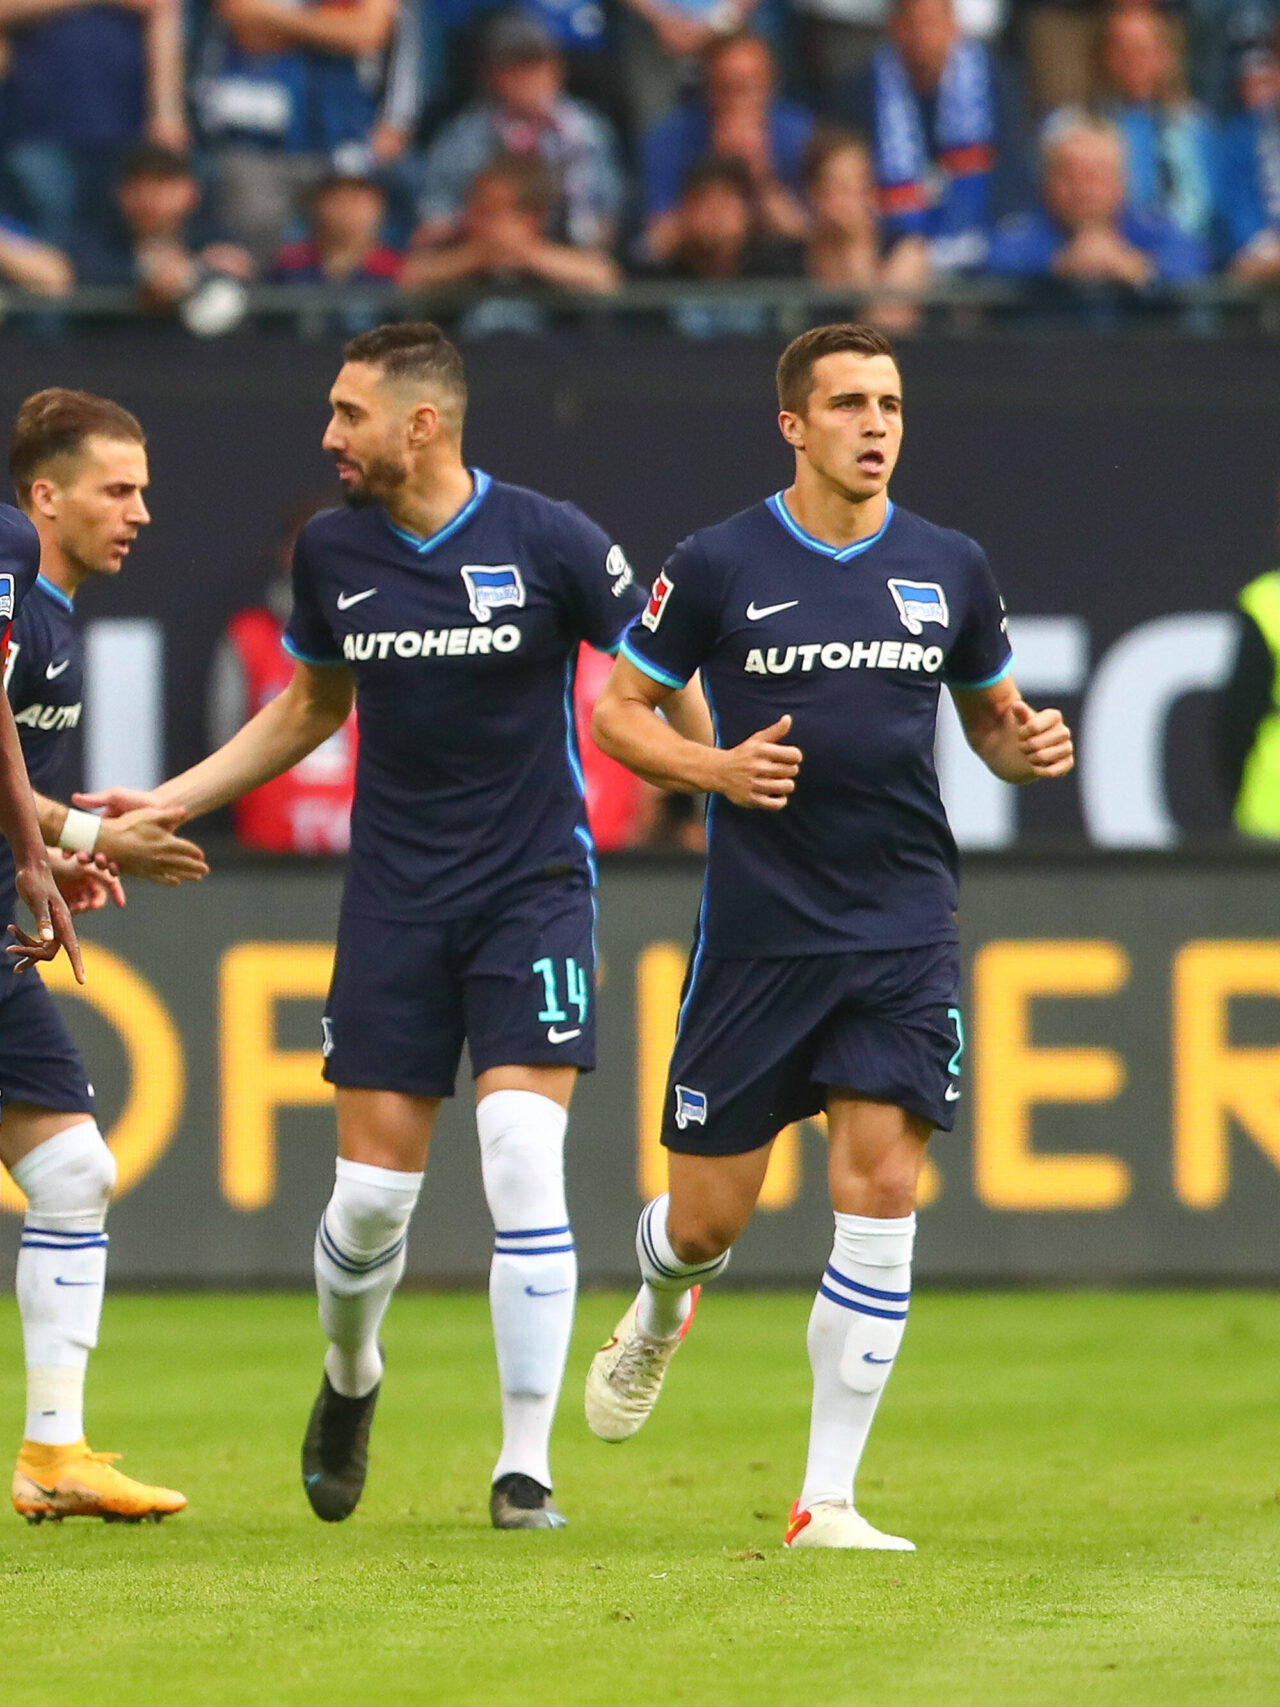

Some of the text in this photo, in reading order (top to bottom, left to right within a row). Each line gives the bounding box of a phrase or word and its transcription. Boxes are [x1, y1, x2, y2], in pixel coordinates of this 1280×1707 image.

[343, 624, 521, 661] AUTOHERO
[744, 641, 944, 675] AUTOHERO
[532, 957, 588, 1023] 14
